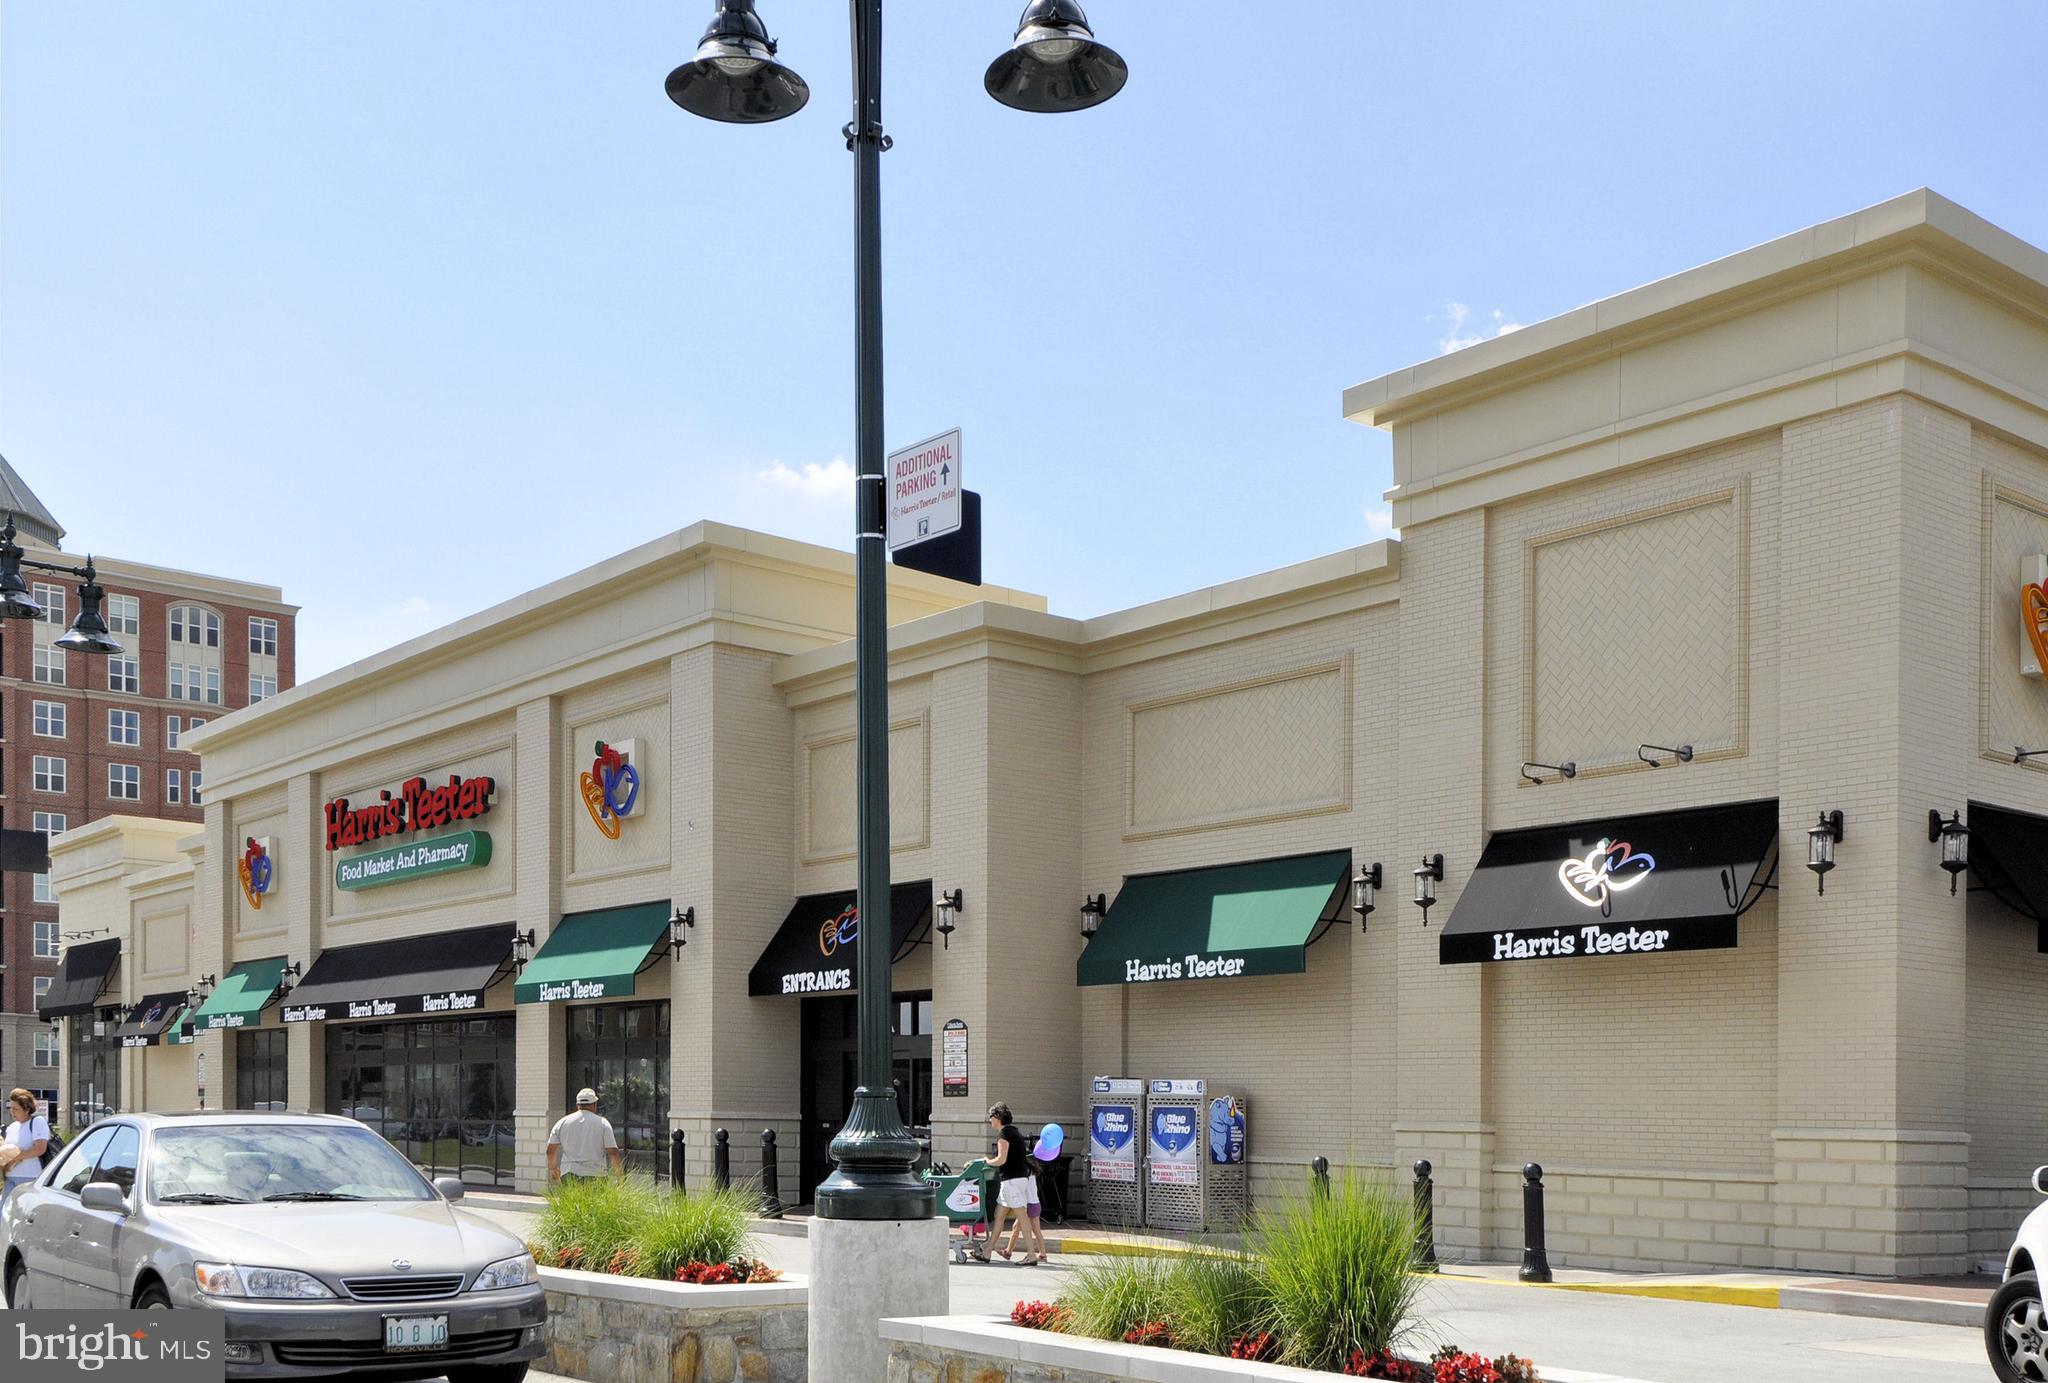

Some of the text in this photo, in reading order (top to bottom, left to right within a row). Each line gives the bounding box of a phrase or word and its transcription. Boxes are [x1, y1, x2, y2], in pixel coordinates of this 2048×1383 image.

[895, 443, 952, 480] ADDITIONAL
[895, 469, 937, 500] PARKING
[900, 502, 919, 516] Harris
[324, 774, 492, 851] Harris Teeter
[341, 842, 469, 881] Food Market And Pharmacy
[1493, 925, 1669, 960] Harris Teeter
[1125, 954, 1245, 982] Harris Teeter
[539, 980, 604, 1001] Harris Teeter
[782, 968, 851, 994] ENTRANCE
[349, 999, 396, 1018] Harris Teeter
[422, 992, 477, 1012] Harris Teeter
[208, 1013, 245, 1028] Harris Teeter
[284, 1006, 326, 1022] Harris Teeter
[1106, 1112, 1125, 1123] Blue
[1166, 1113, 1187, 1124] Blue
